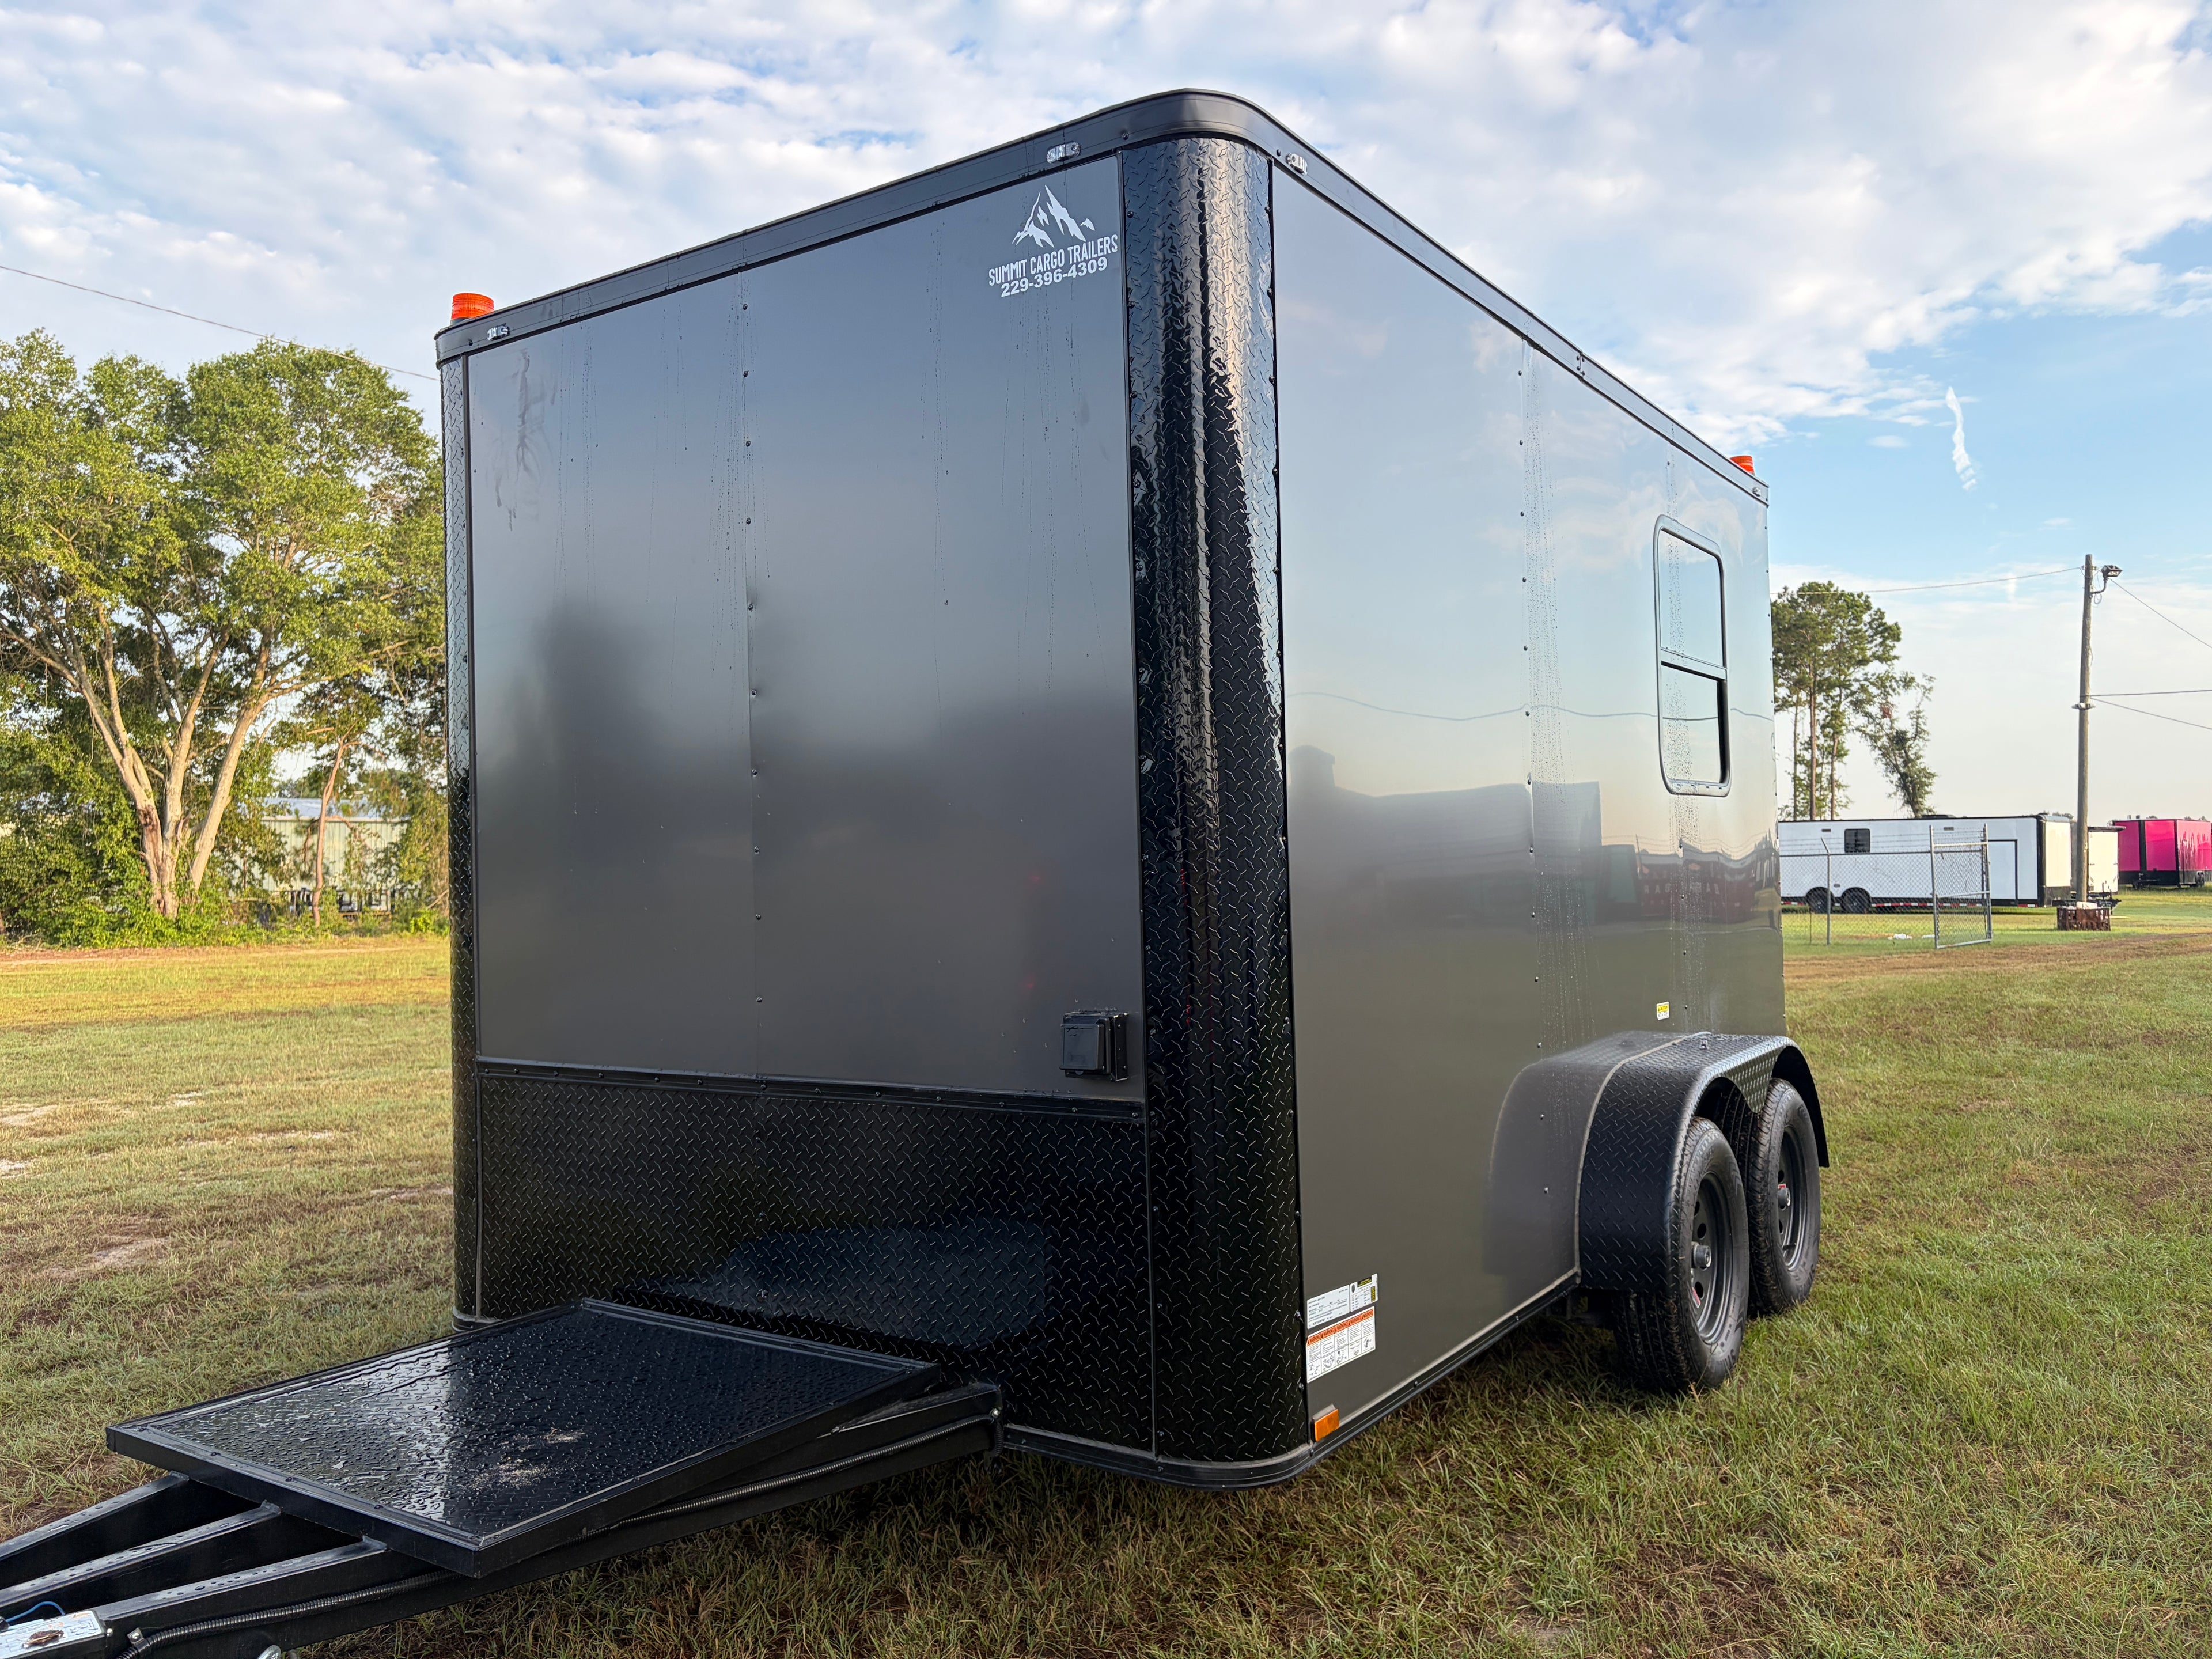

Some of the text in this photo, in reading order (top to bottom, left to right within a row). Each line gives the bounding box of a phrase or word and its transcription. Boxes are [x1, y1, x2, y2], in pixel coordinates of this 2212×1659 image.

[988, 234, 1118, 286] SUMMIT CARGO TRAILERS
[1001, 256, 1108, 297] 229-396-4309
